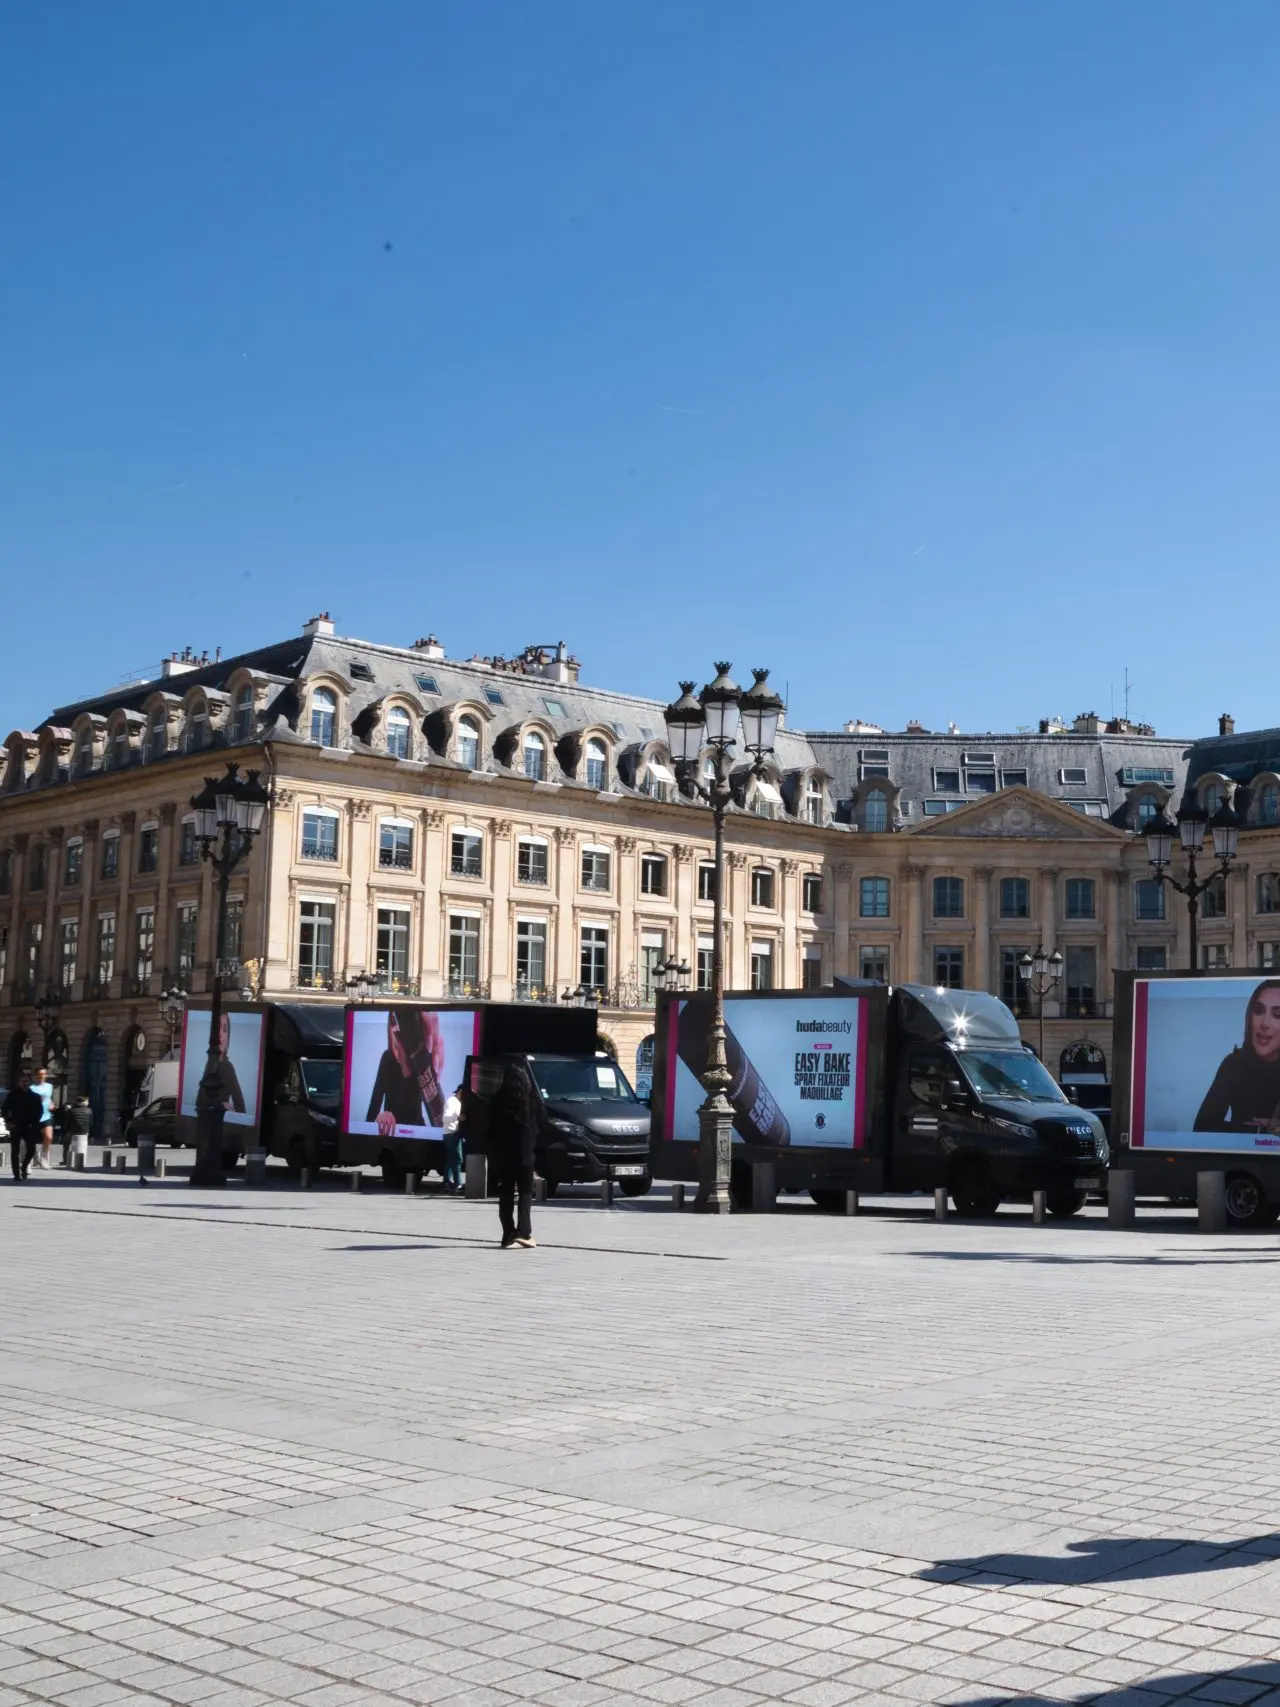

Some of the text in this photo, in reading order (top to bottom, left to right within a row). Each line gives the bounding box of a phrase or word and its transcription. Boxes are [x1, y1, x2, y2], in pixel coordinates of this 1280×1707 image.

[796, 1019, 852, 1034] hudabeauty
[795, 1052, 851, 1072] EASY BAKE
[794, 1073, 850, 1087] SPRAY FIXATEUR
[800, 1087, 843, 1101] MAQUILLAGE
